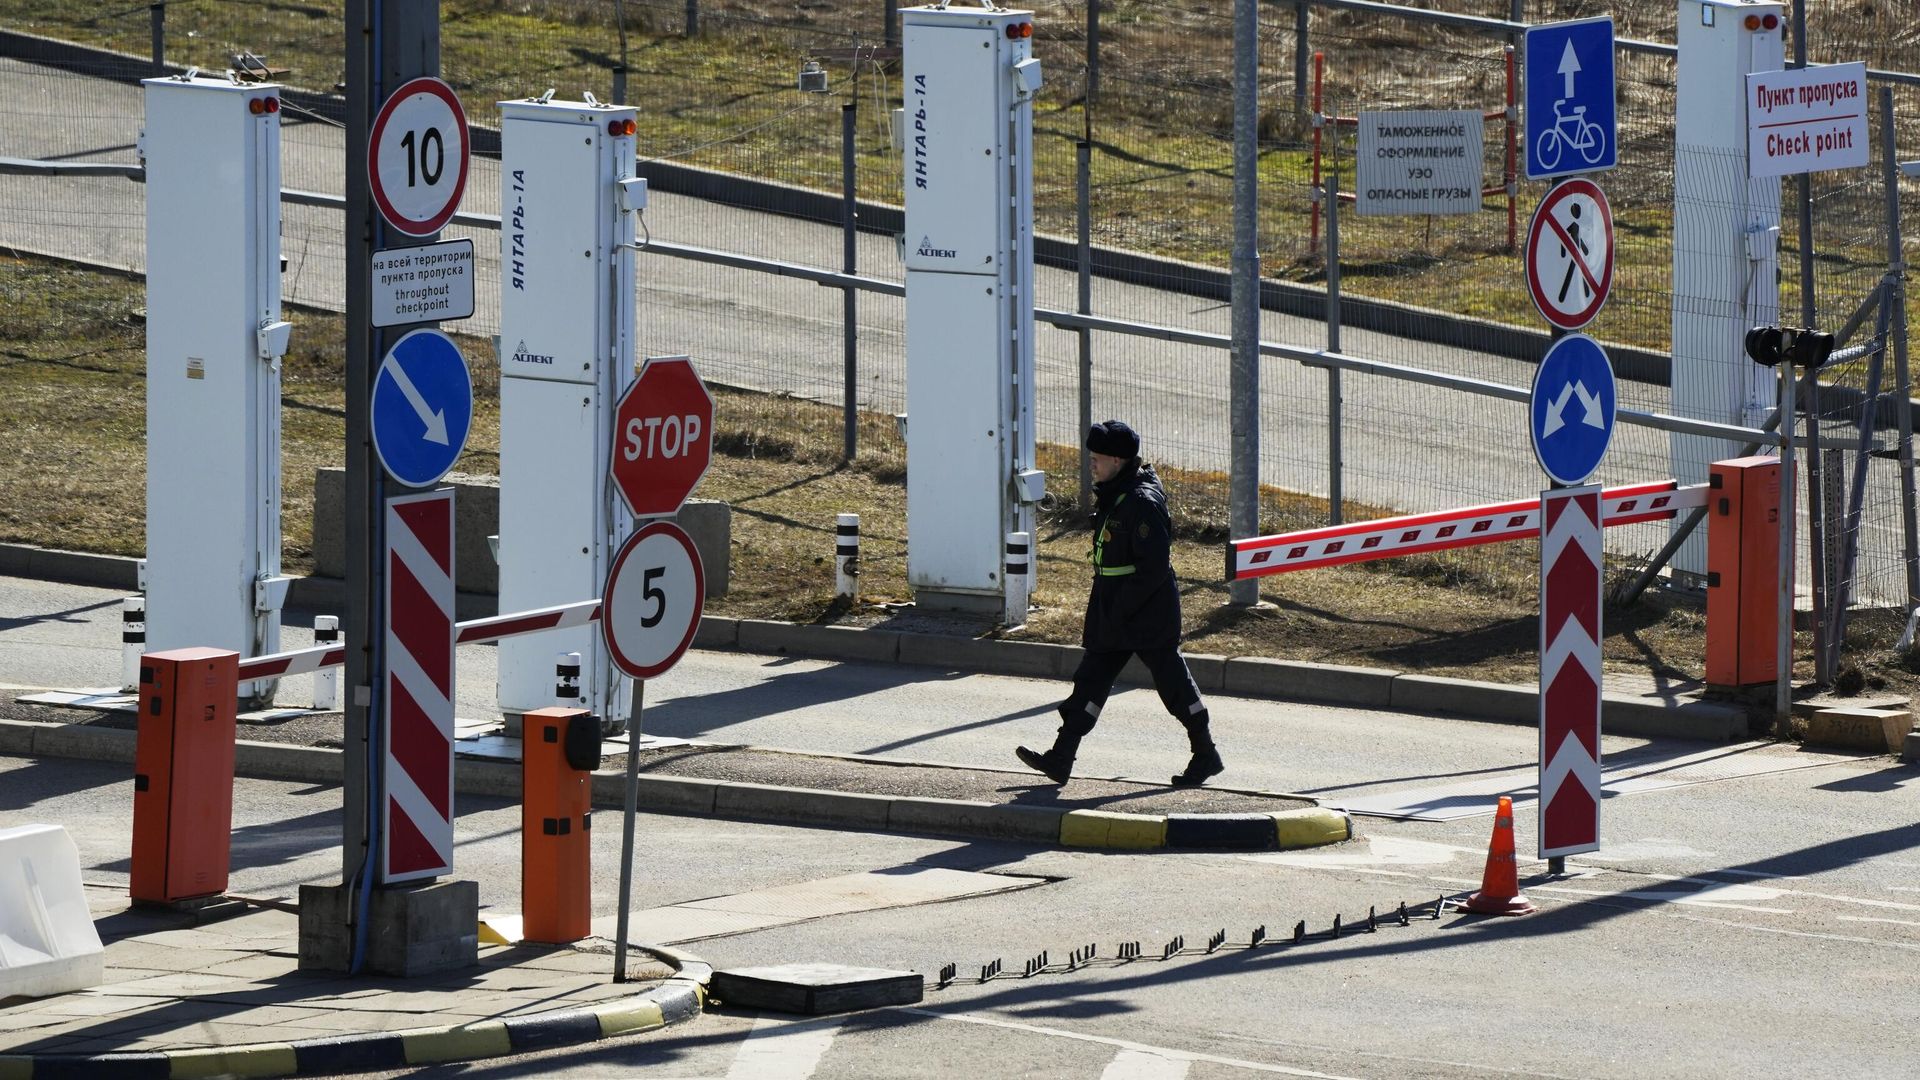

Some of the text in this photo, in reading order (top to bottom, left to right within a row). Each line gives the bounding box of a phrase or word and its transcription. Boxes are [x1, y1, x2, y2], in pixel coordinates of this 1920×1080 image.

[1757, 80, 1858, 113] Пункт пропуска
[1377, 125, 1465, 138] ТАМОЖЕННОЕ
[1767, 126, 1852, 157] Check point
[400, 126, 444, 188] 10
[1376, 146, 1465, 159] ОФОРМЛЕНИЕ
[1408, 168, 1433, 179] УЭО
[1367, 187, 1471, 200] ОПАСНЫЕ ГРУЗЫ
[373, 251, 471, 271] на всей территории
[916, 248, 957, 259] АСПЕКТ
[381, 266, 463, 286] пункта пропуска
[395, 283, 449, 300] throughout
[395, 297, 449, 314] checkpoint
[512, 352, 554, 365] АСПЕКТ
[623, 414, 701, 462] STOP
[640, 565, 666, 629] 5
